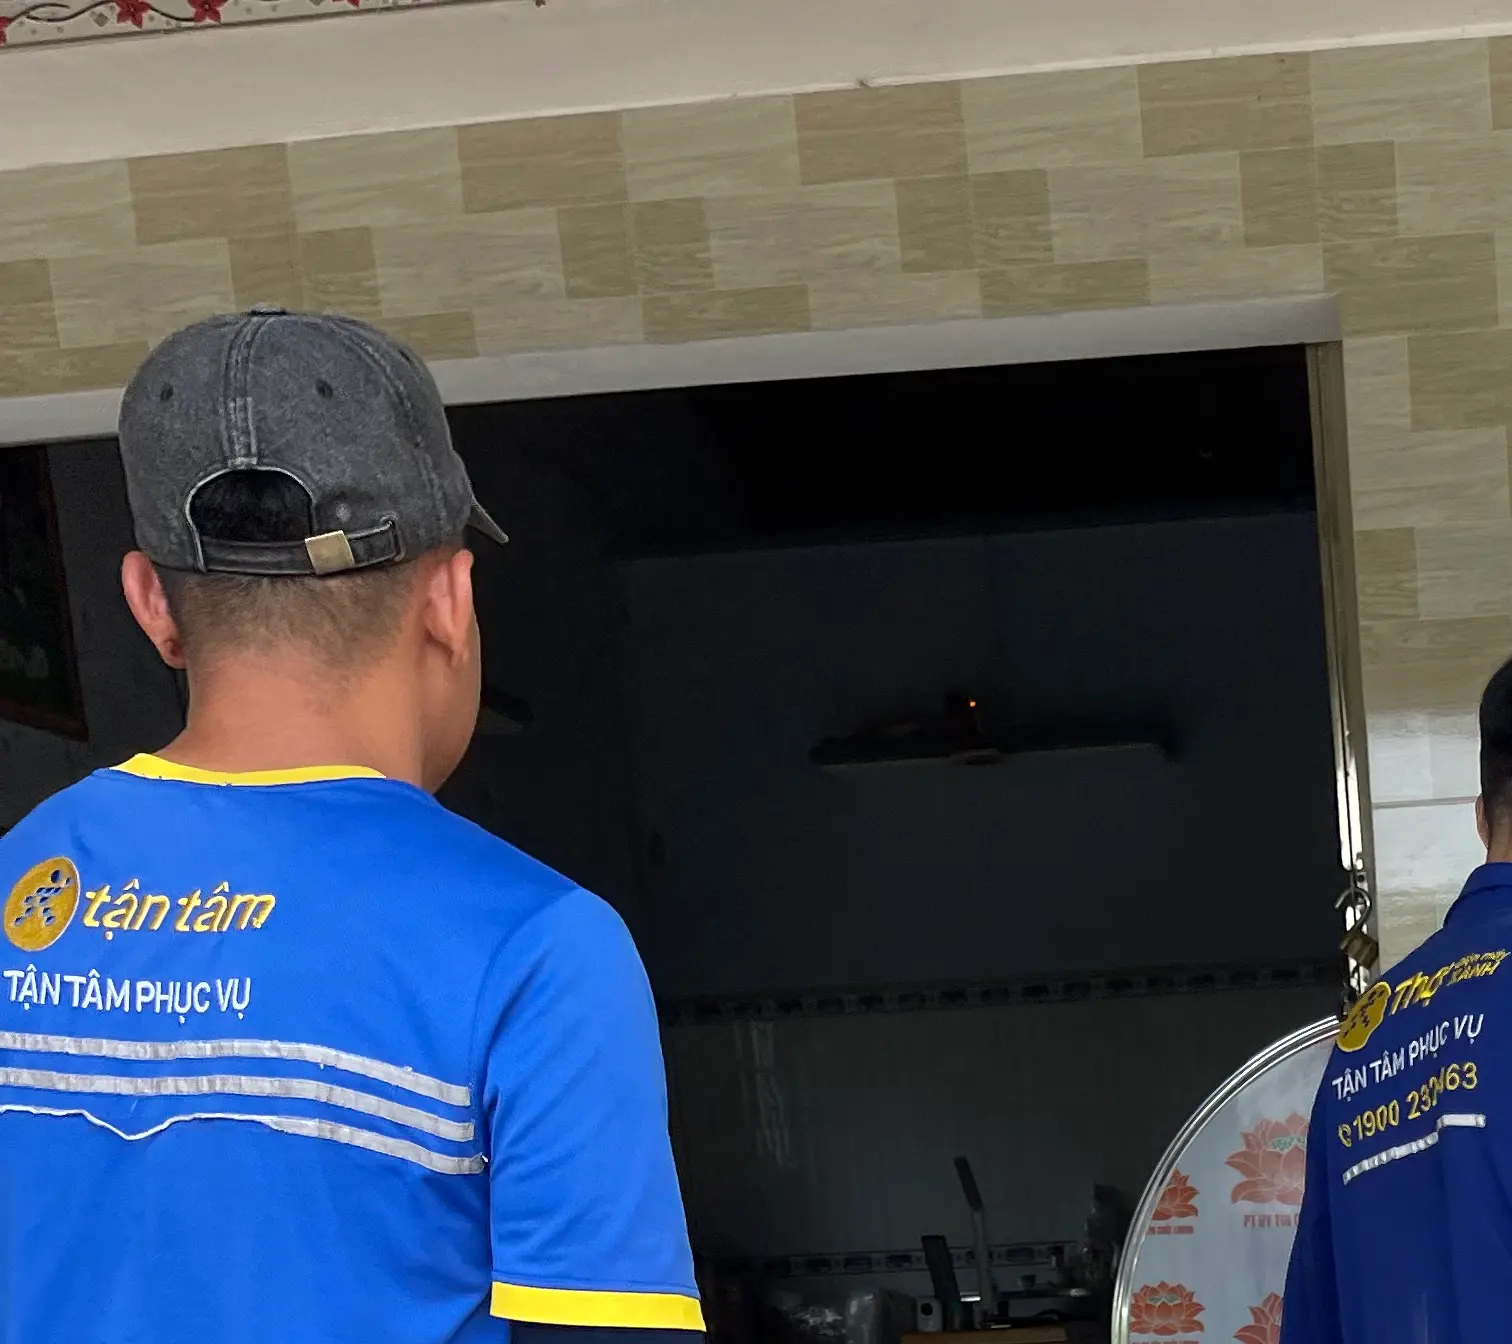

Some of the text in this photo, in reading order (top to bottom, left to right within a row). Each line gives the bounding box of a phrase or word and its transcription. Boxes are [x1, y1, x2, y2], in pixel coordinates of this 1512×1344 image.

[82, 878, 276, 940] tận tâm
[2, 963, 252, 1025] TẬN TÂM PHỤC VỤ
[1331, 1013, 1485, 1102] TẬN TÂM PHỤC VỤ
[1352, 1099, 1400, 1142] 1900
